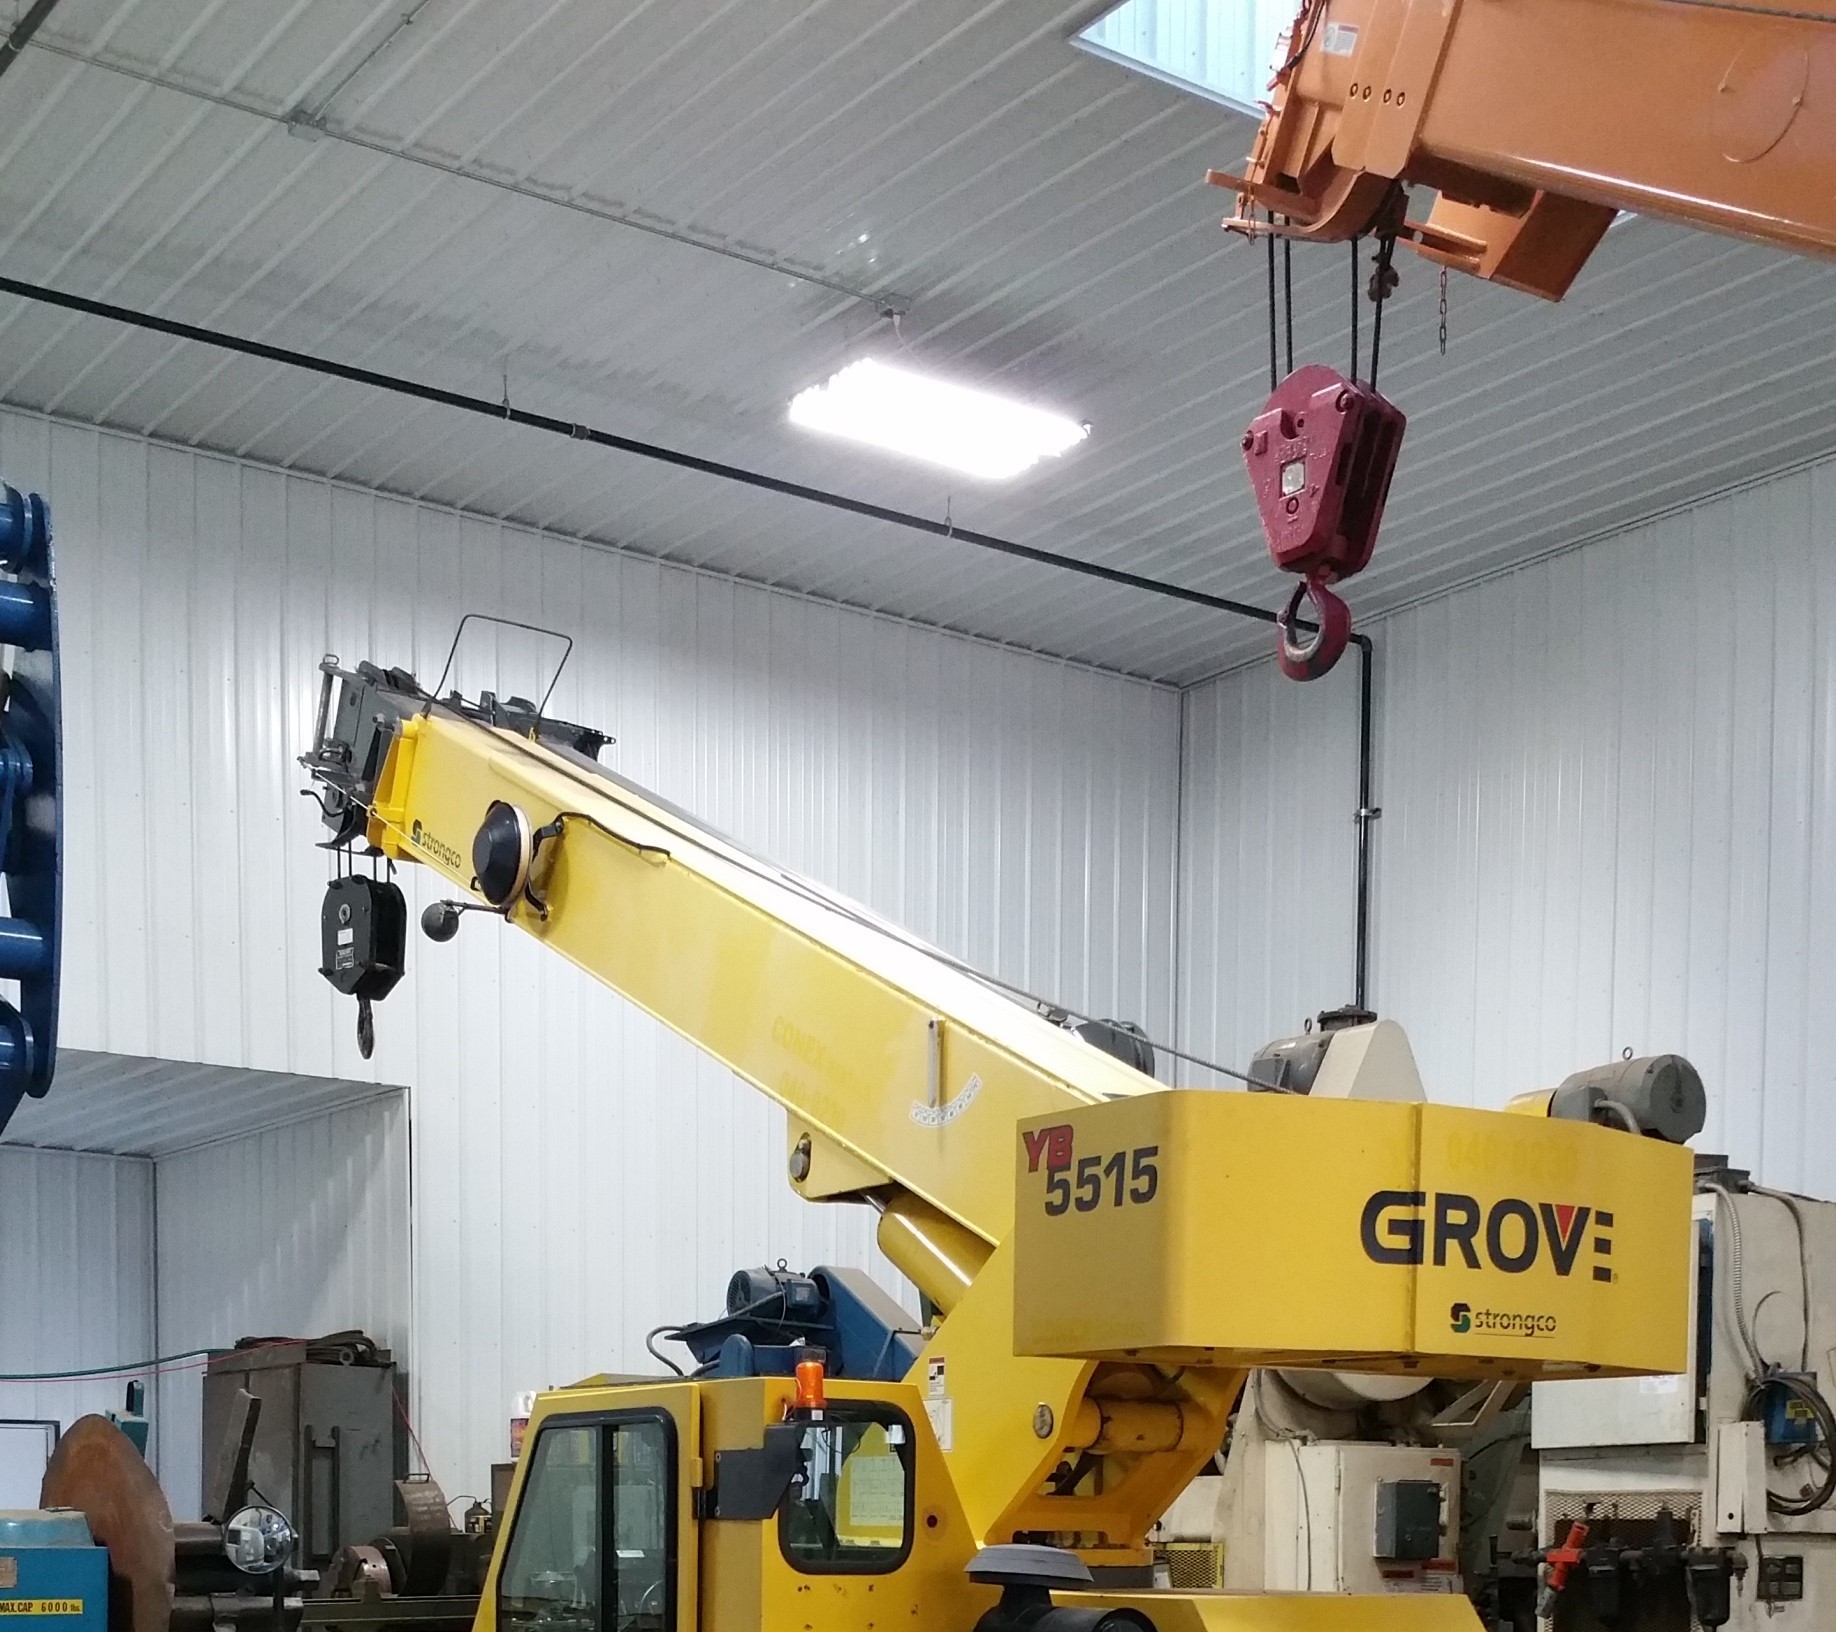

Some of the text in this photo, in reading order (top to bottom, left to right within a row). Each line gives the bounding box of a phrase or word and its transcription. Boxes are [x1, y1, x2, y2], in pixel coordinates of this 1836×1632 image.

[422, 832, 461, 868] strongco
[1022, 1124, 1074, 1173] YB
[1044, 1145, 1159, 1216] 5515
[1360, 1190, 1614, 1283] GROVE
[1475, 1308, 1556, 1337] strongco
[41, 1601, 68, 1613] 6000
